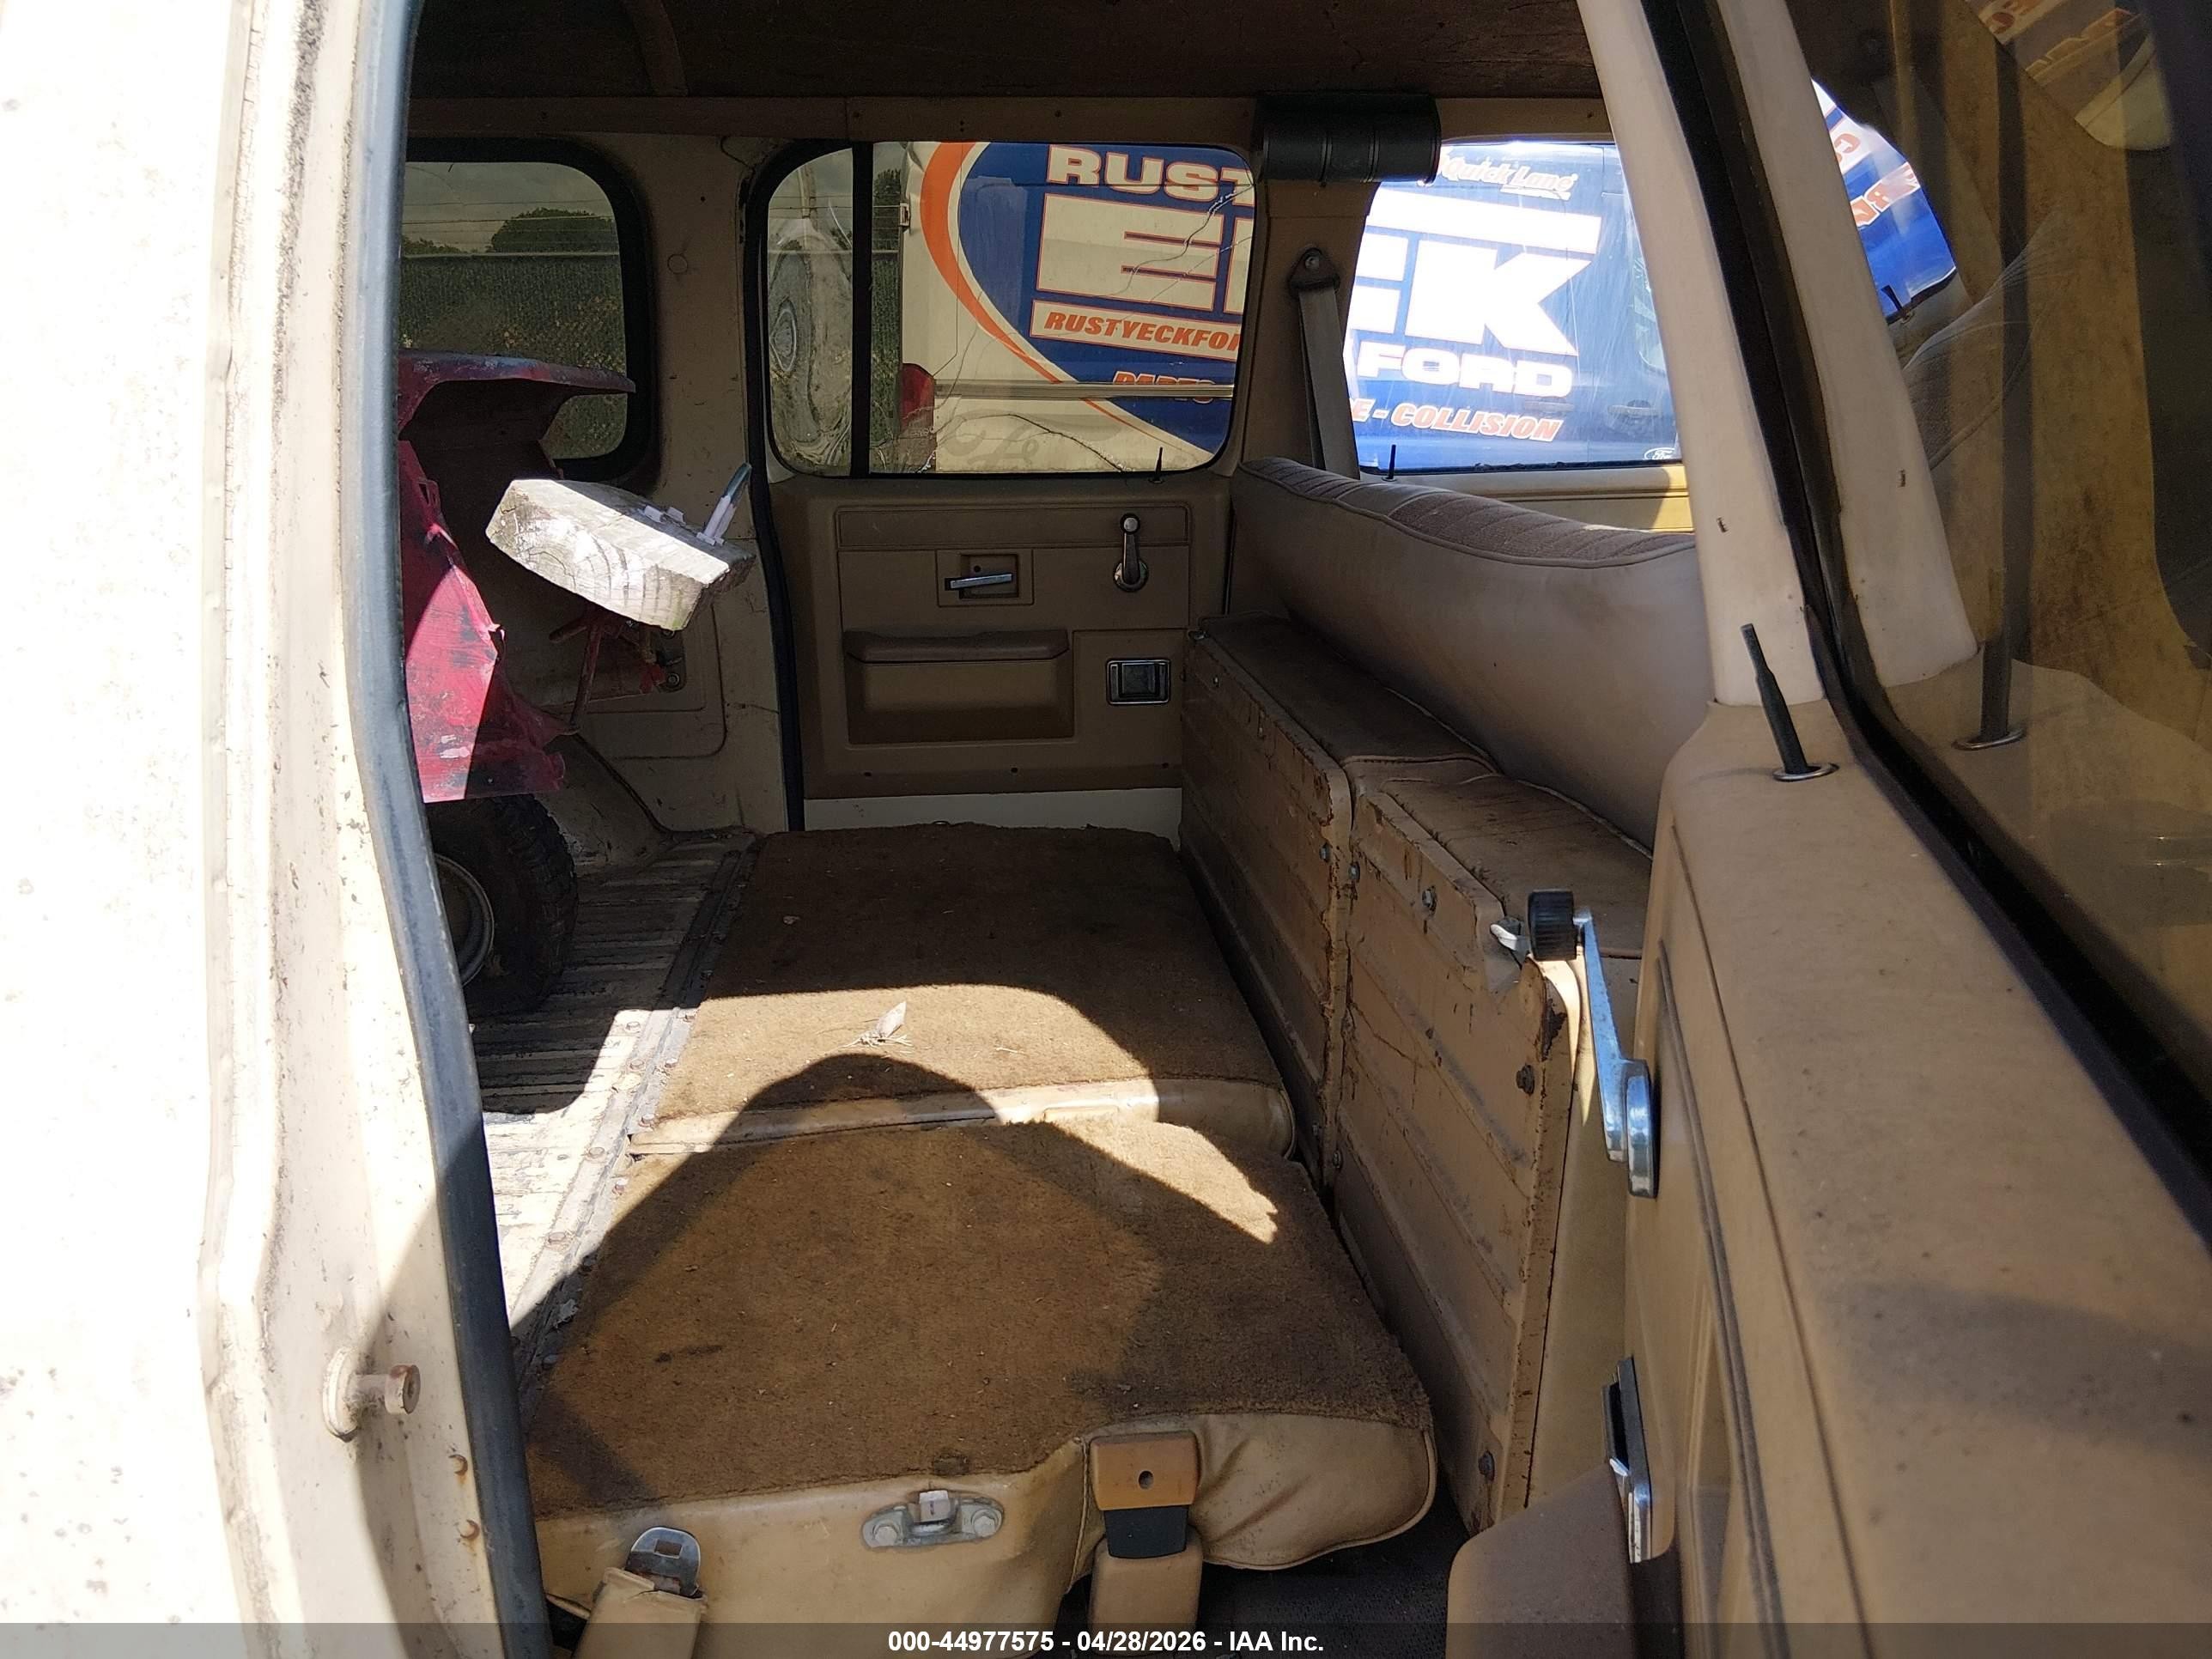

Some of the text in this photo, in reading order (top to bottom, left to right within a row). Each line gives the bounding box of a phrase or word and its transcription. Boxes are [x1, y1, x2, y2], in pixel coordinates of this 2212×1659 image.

[1510, 165, 1575, 191] Lane
[1356, 341, 1573, 398] FORD
[1390, 403, 1564, 441] COLLISION
